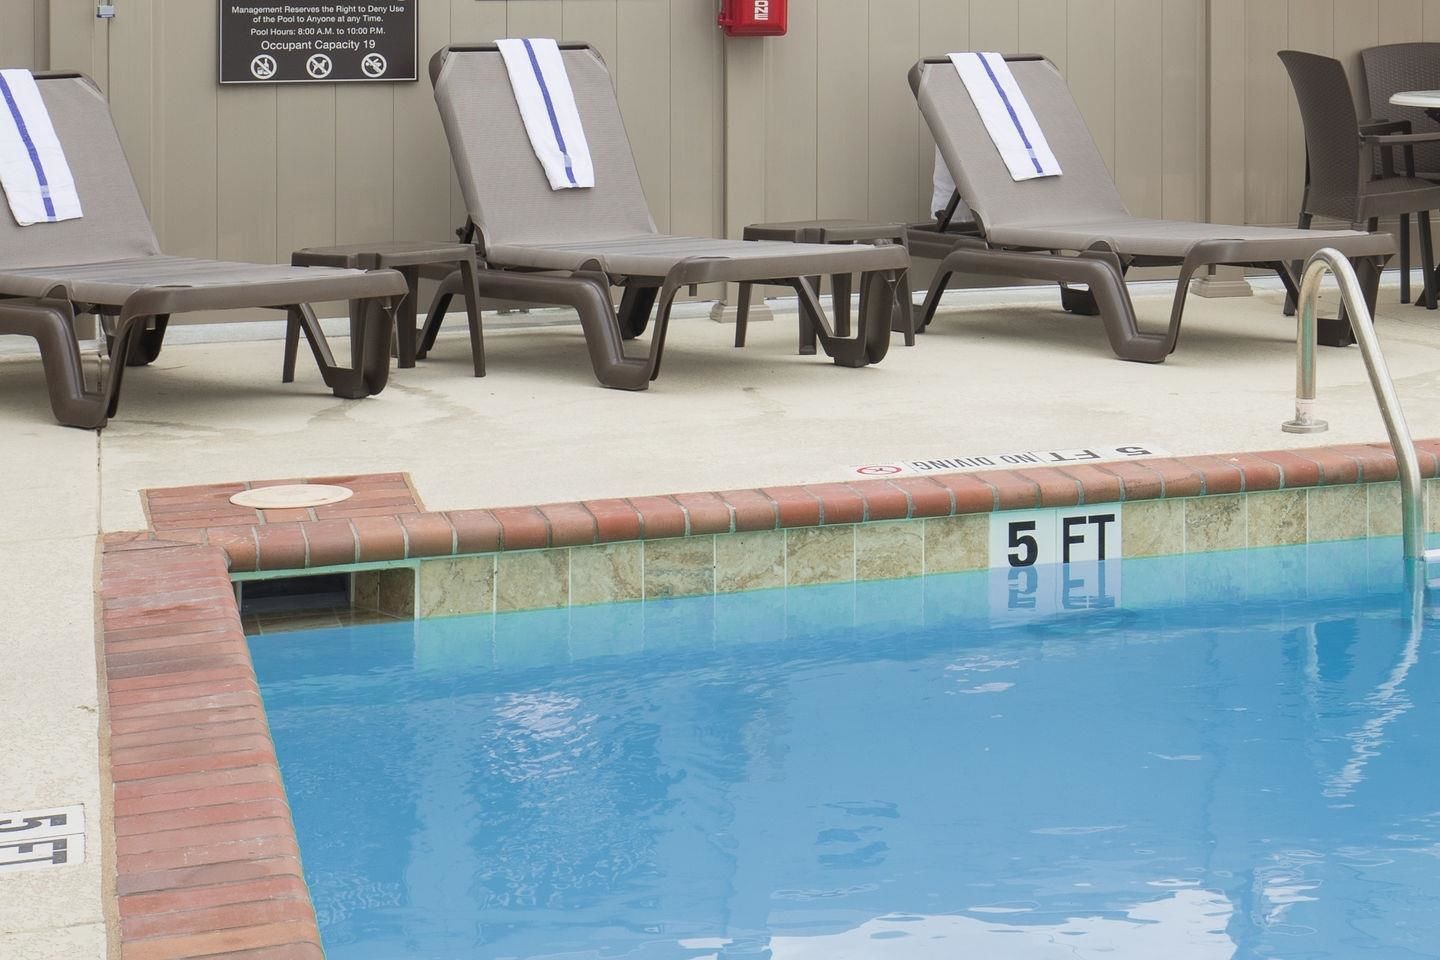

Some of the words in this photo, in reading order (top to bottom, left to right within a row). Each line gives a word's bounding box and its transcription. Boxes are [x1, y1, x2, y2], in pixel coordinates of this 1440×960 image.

[231, 6, 283, 15] Management
[284, 5, 320, 13] Reserves
[321, 5, 334, 13] the
[336, 5, 356, 14] Right
[367, 5, 388, 14] Deny
[253, 14, 261, 23] of
[277, 15, 295, 23] Pool
[306, 15, 336, 24] Anyone
[346, 16, 361, 24] any
[362, 14, 384, 22] Time.
[250, 28, 268, 36] Pool
[270, 28, 296, 36] Hours:
[297, 27, 315, 35] 8:00
[316, 27, 335, 35] A.M.
[347, 27, 368, 35] 10:00
[261, 40, 312, 51] Occupant
[314, 39, 360, 51] Capacity
[363, 39, 376, 49] 19
[1049, 449, 1101, 462] FT
[1115, 446, 1152, 456] 5
[912, 455, 995, 471] DIVING
[1000, 451, 1037, 464] NO
[1008, 520, 1038, 567] 5
[1063, 514, 1115, 563] FT
